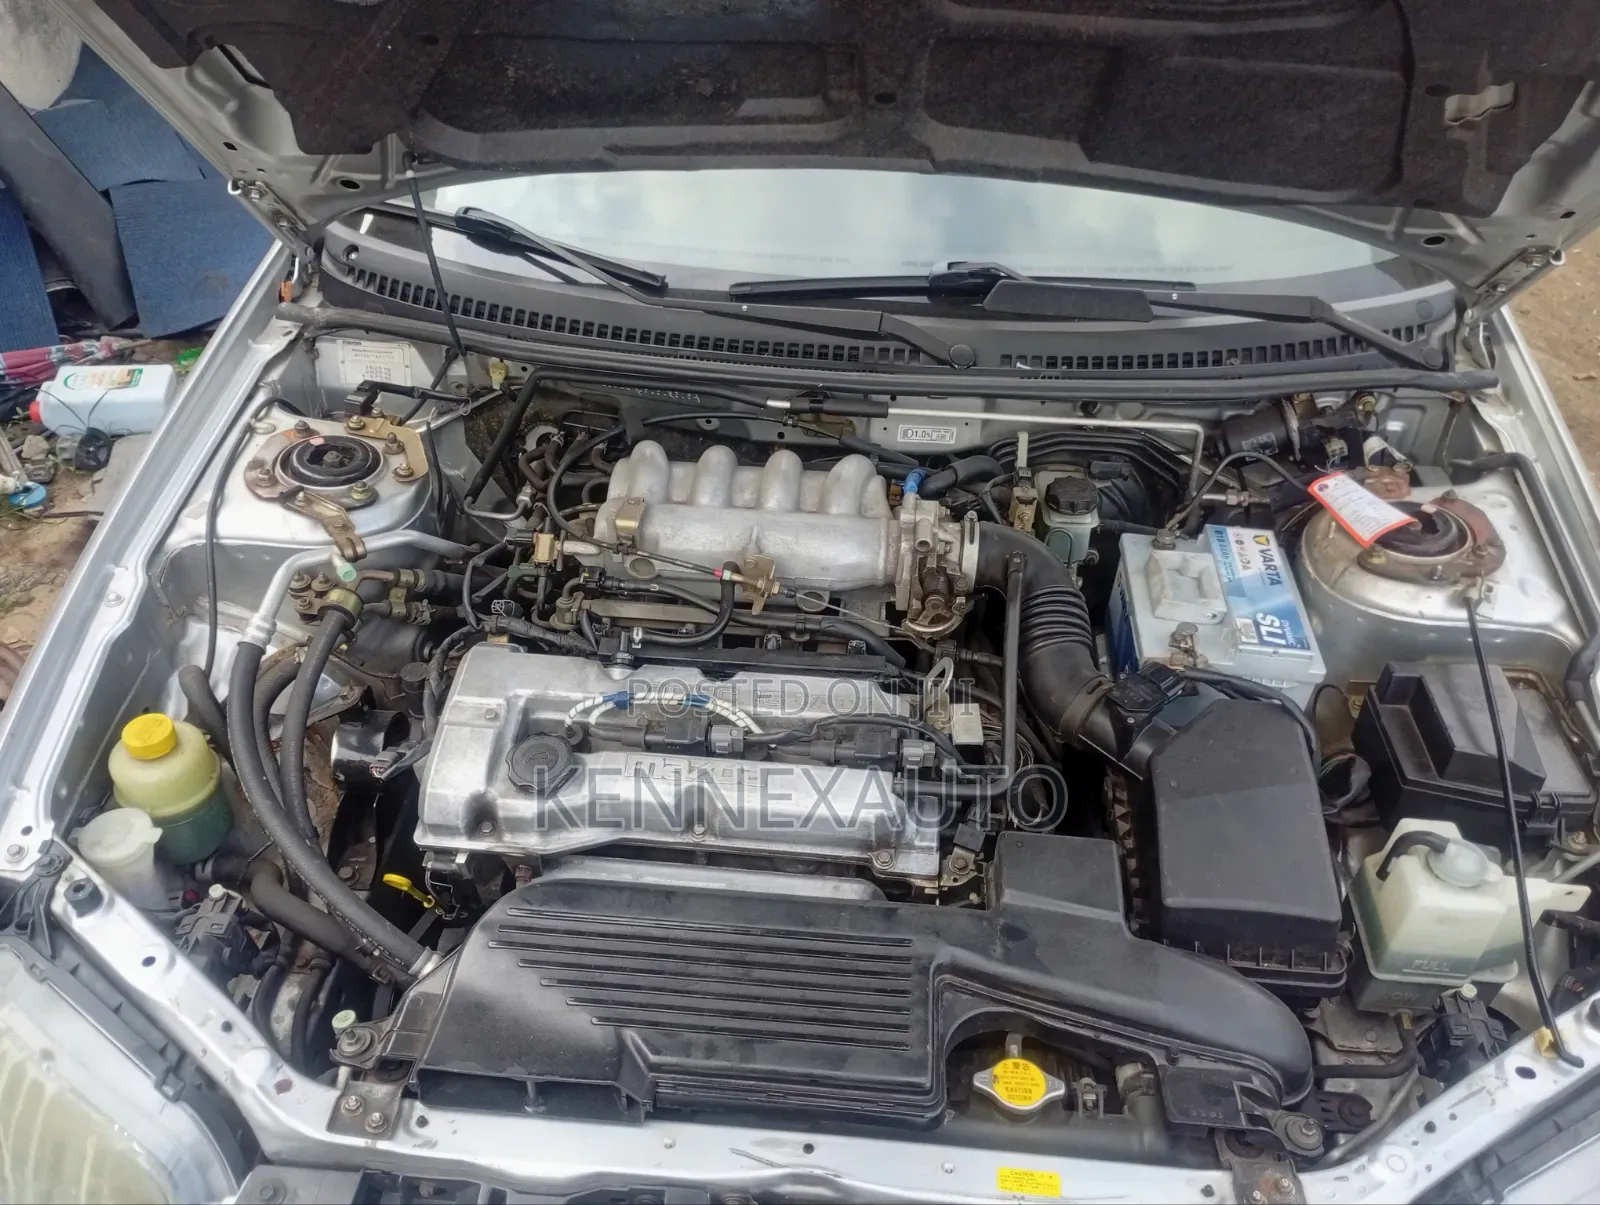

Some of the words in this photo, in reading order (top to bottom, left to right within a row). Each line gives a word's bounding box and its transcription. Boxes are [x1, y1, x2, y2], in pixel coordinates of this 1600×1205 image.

[1259, 548, 1283, 586] VARTA
[1256, 611, 1287, 645] SLI
[1411, 959, 1450, 972] FULL
